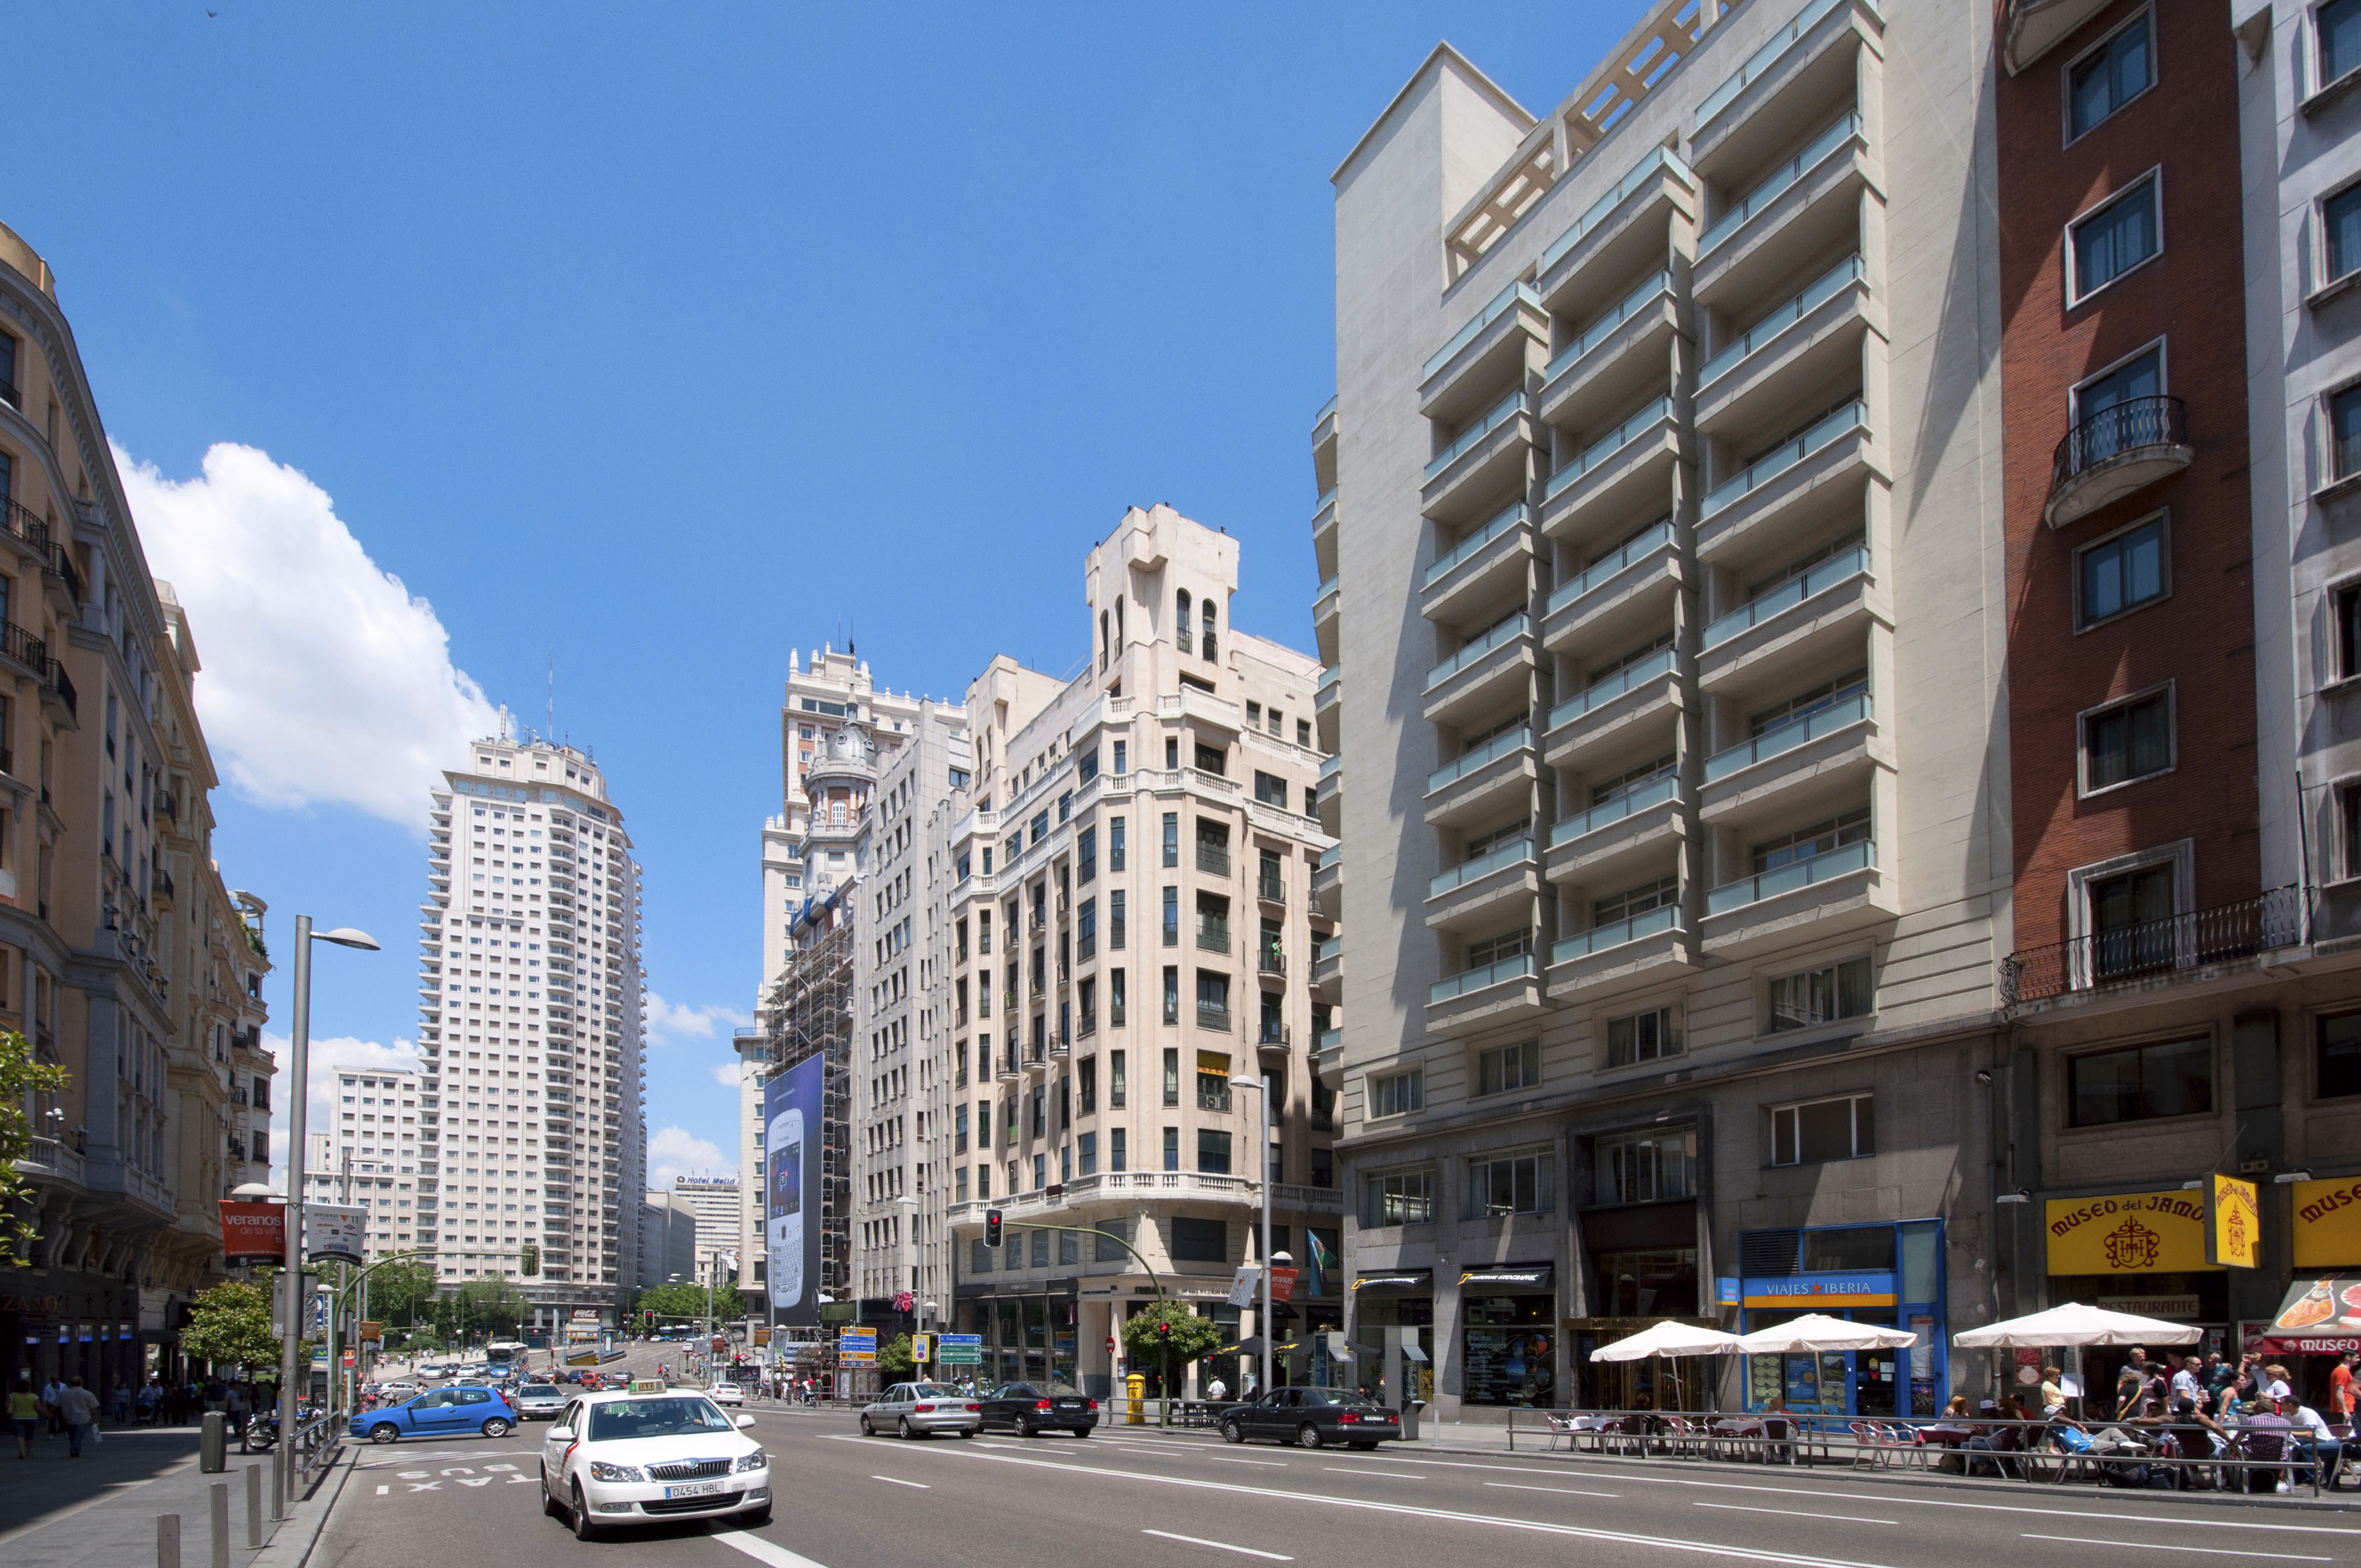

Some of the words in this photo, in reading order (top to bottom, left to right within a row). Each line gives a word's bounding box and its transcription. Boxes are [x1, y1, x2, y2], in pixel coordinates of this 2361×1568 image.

[225, 1215, 282, 1226] veranos
[2050, 1200, 2118, 1237] MUSEO
[2121, 1199, 2141, 1211] del
[2145, 1196, 2204, 1224] JAMO
[240, 1226, 253, 1235] de
[255, 1226, 263, 1235] la
[1271, 1275, 1293, 1285] eranos
[1766, 1283, 1809, 1297] VIAJES
[1825, 1282, 1871, 1294] IBERIA
[2100, 1299, 2198, 1313] RESTAURANTE
[2300, 1339, 2359, 1351] MUSEO
[638, 1382, 655, 1391] TAXI
[607, 1404, 628, 1414] LIBRE
[396, 1463, 520, 1479] BUS
[376, 1473, 542, 1495] TAXI
[672, 1486, 699, 1497] 0454
[702, 1483, 721, 1495] HBL
